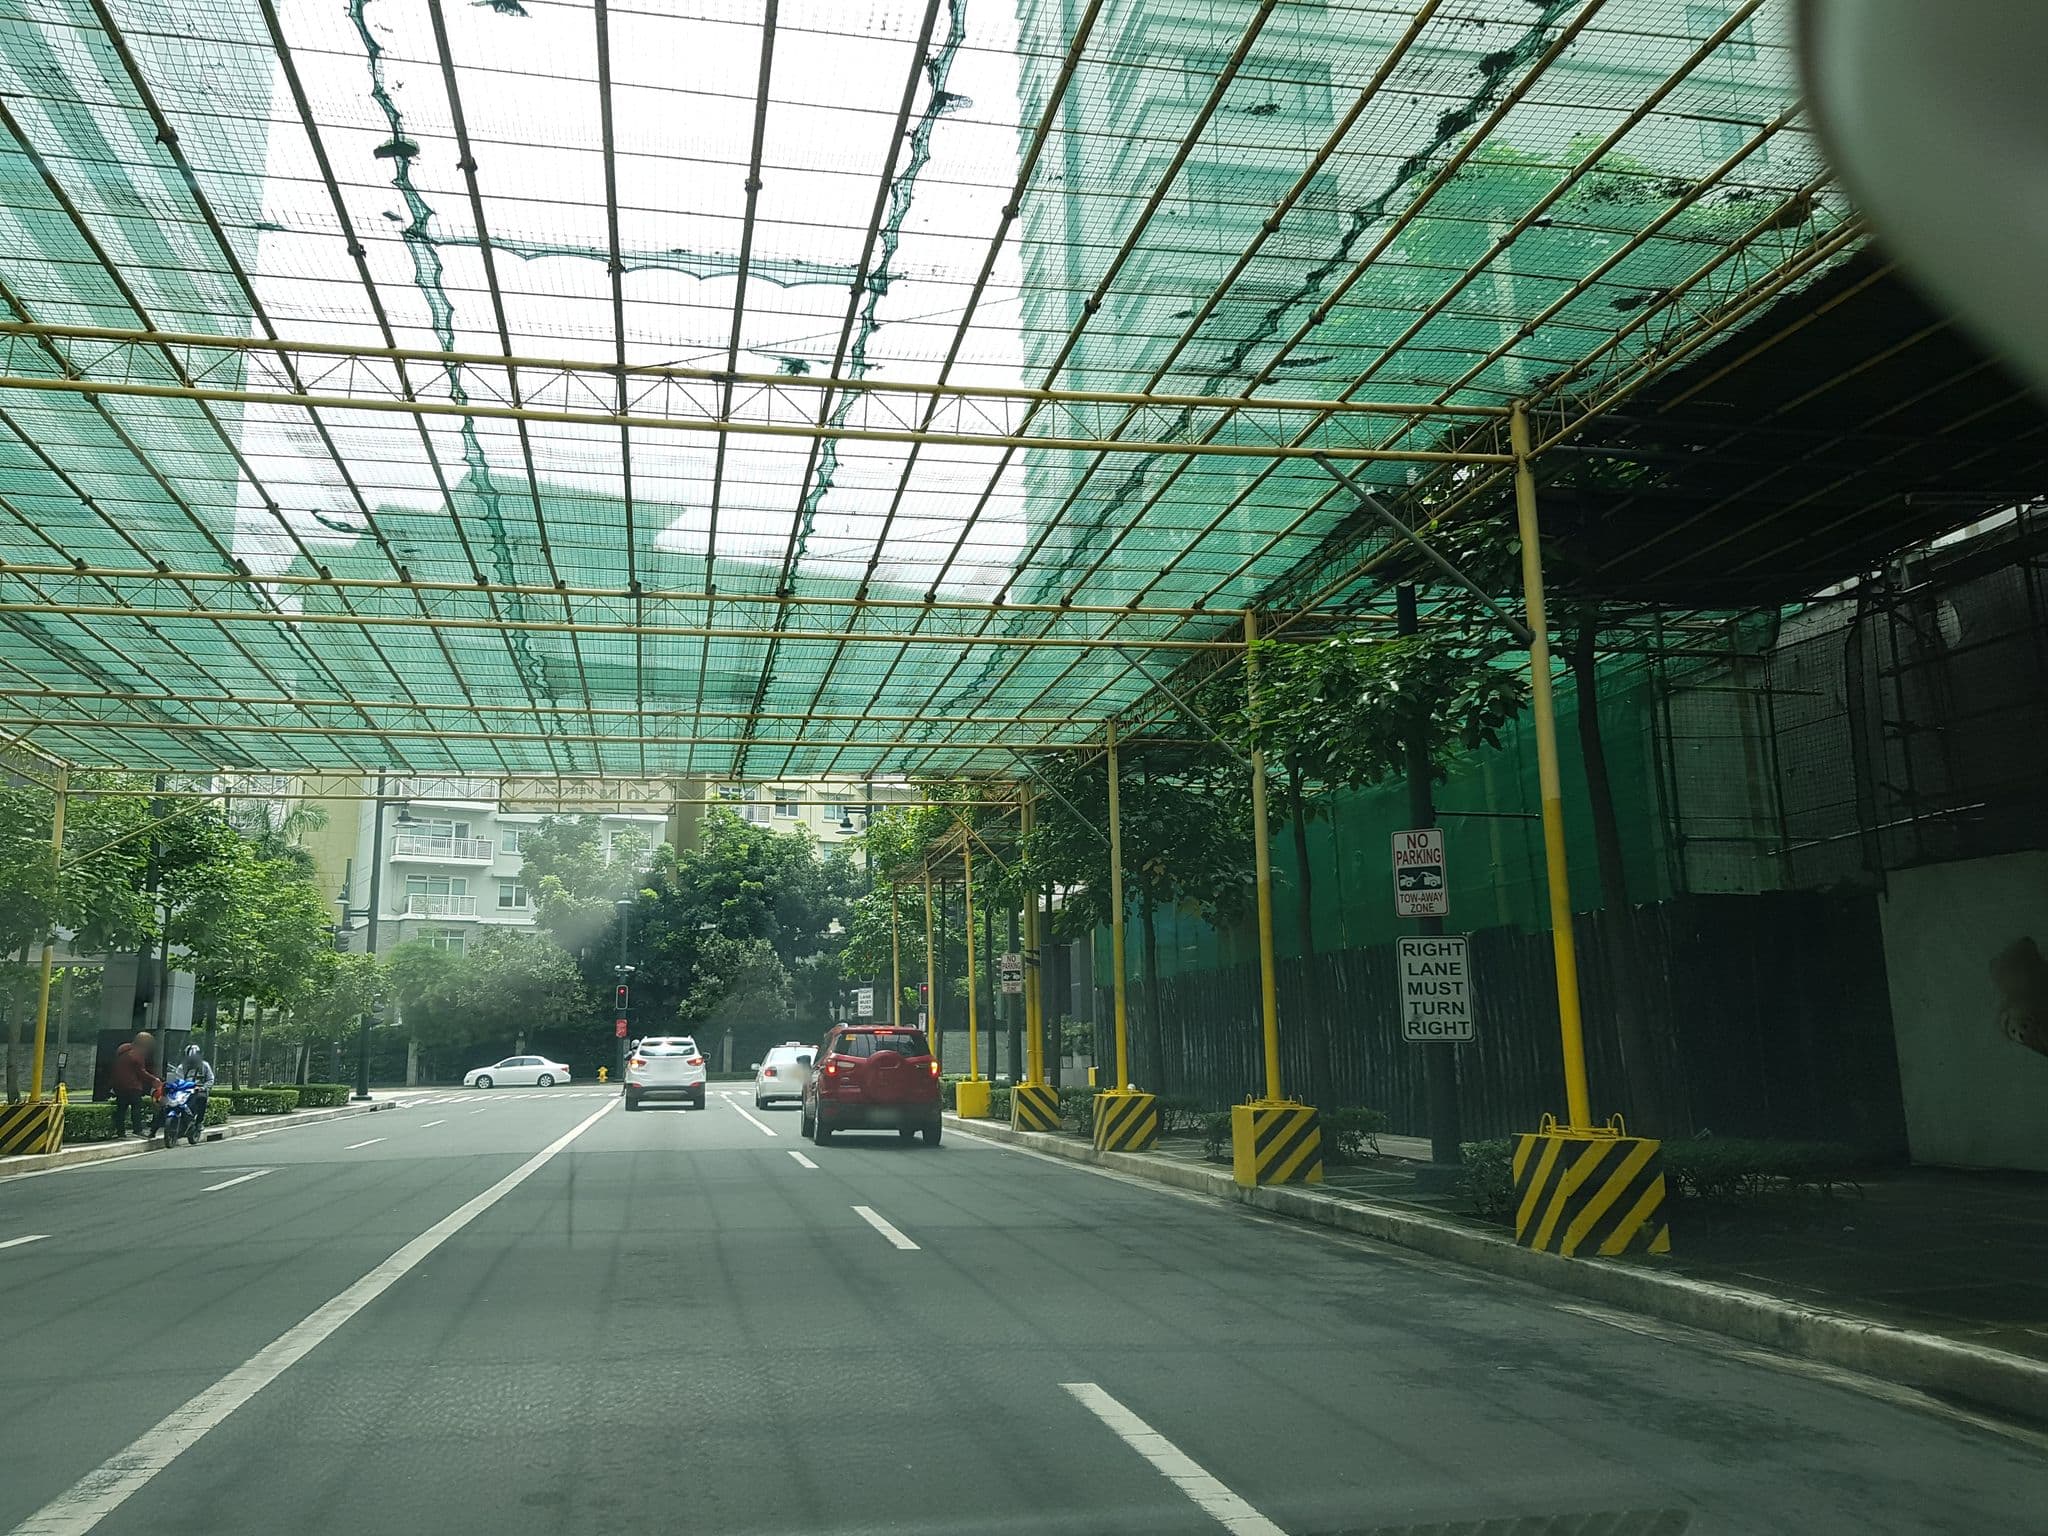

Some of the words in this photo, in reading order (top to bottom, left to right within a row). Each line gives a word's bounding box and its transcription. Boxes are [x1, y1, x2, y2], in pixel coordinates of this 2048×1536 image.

[1406, 833, 1428, 849] NO
[1396, 848, 1441, 866] PARKING
[1400, 892, 1443, 904] TOW-AWAY
[1410, 903, 1435, 913] ZONE
[1402, 943, 1465, 957] RIGHT
[1006, 955, 1016, 963] NO
[1407, 962, 1462, 976] LANE
[1407, 982, 1464, 995] MUST
[1409, 1001, 1465, 1015] TURN
[1407, 1021, 1470, 1035] RIGHT
